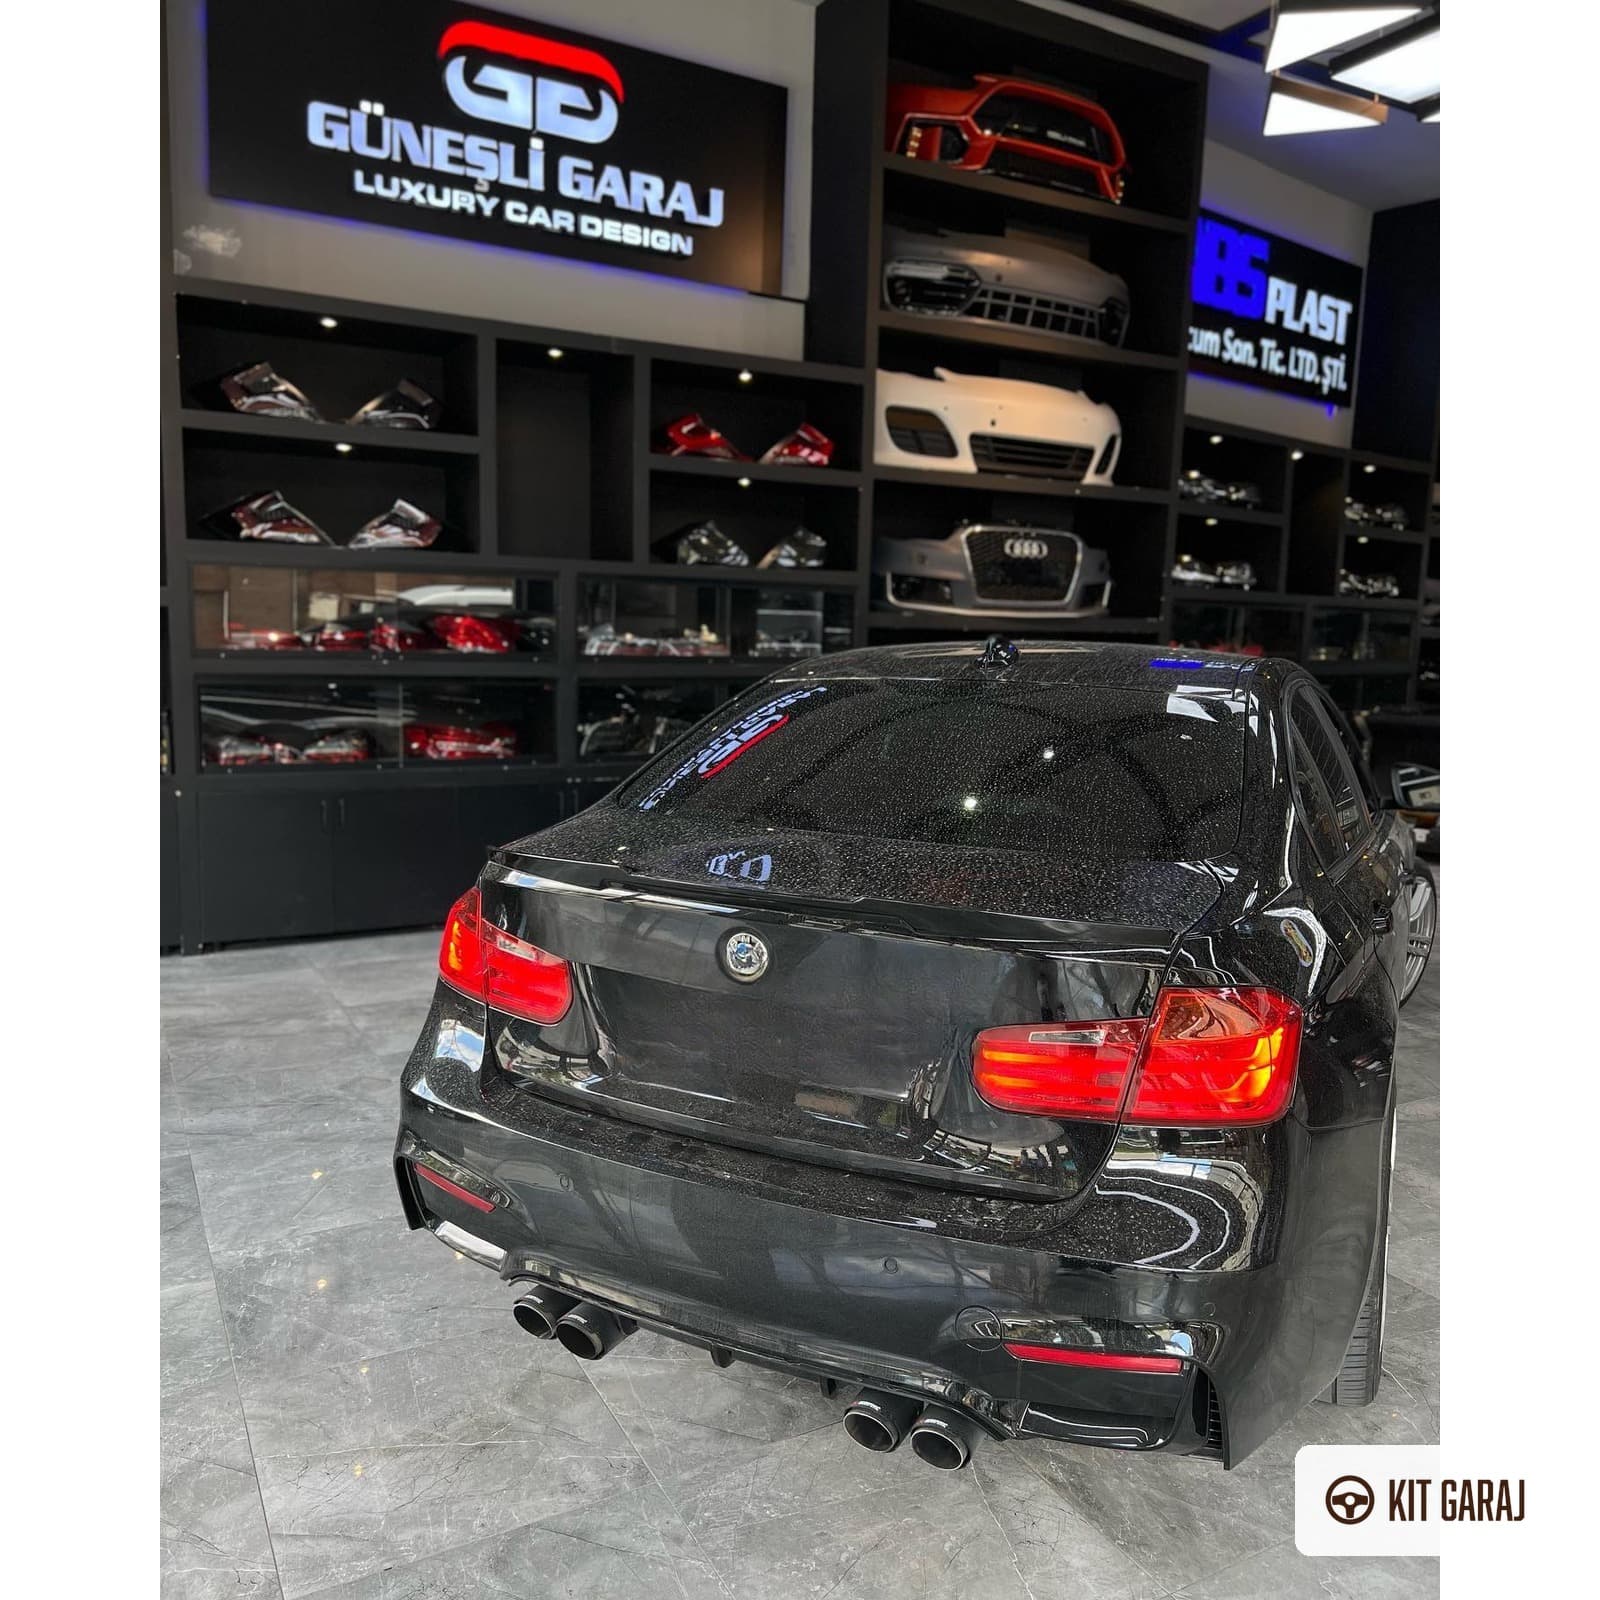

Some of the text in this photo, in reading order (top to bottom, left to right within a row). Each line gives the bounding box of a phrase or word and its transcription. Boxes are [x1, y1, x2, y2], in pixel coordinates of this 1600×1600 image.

[307, 99, 725, 228] GÜNEŞLİ GARAJ
[353, 169, 694, 256] LUXURY CAR DESIGN
[1264, 276, 1353, 346] PLAST
[1288, 345, 1321, 385] LTD.
